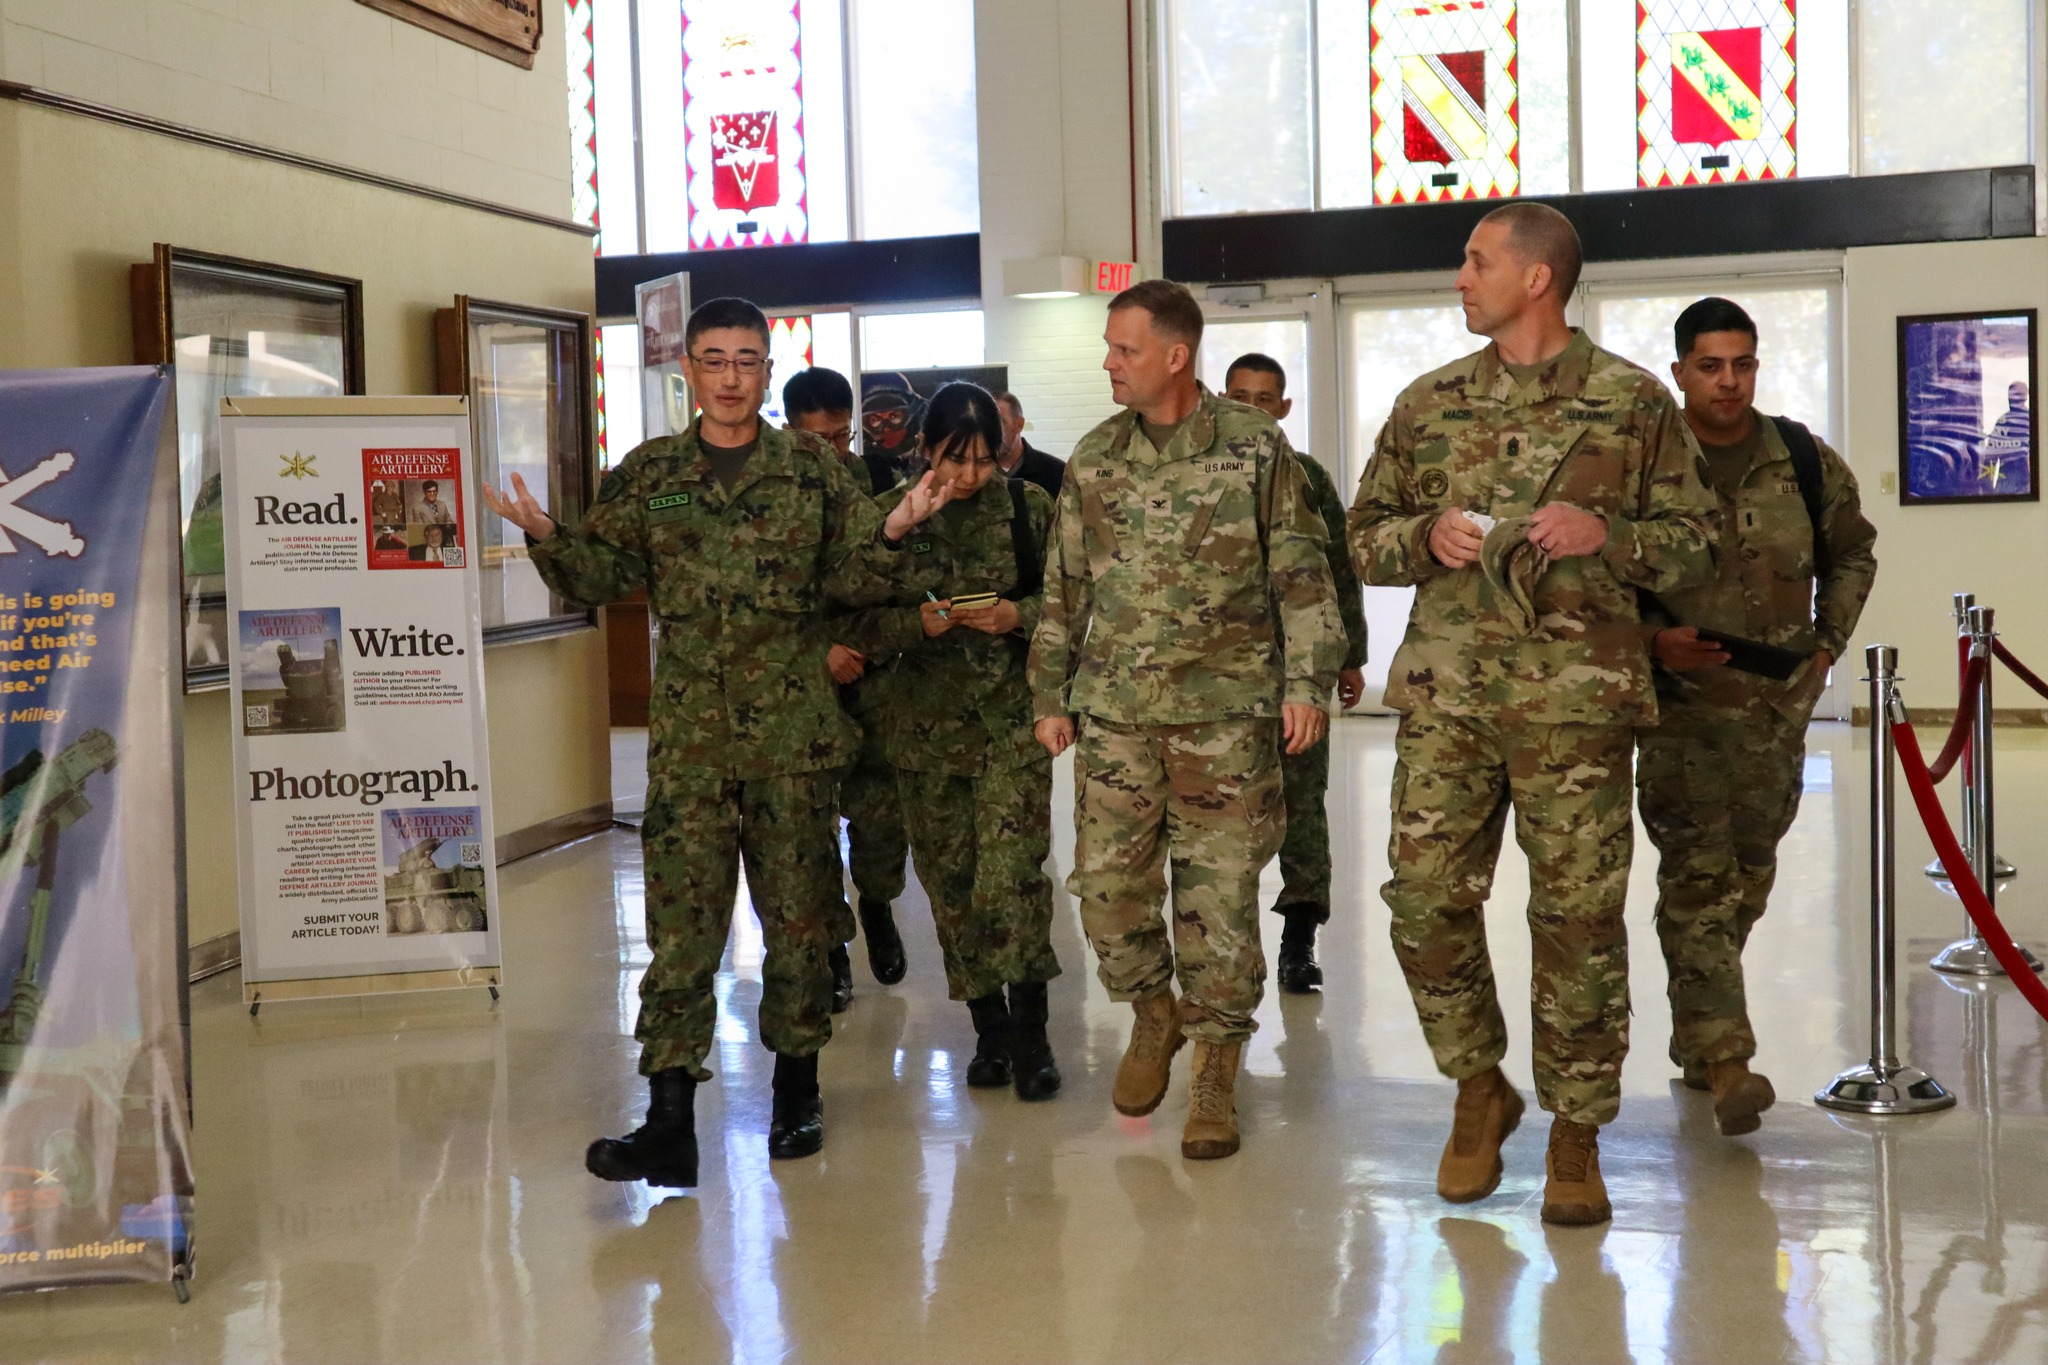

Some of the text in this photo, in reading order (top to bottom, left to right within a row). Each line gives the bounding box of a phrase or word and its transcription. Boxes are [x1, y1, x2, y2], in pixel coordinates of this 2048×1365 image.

[1098, 262, 1133, 292] EXIT
[372, 454, 449, 464] AIR DEFENSE
[380, 464, 445, 474] ARTILLERY
[1095, 468, 1114, 478] KING
[1220, 462, 1244, 472] ARMY
[651, 495, 686, 507] JAPAN
[254, 493, 358, 525] Read.
[24, 592, 43, 608] is
[49, 589, 115, 610] going
[0, 615, 17, 631] if
[348, 625, 464, 657] Write.
[57, 652, 92, 669] Air
[11, 707, 66, 723] Milley
[249, 761, 478, 805] Photograph.
[414, 815, 473, 827] DEFENSE
[398, 826, 468, 839] ARTILLERY
[301, 844, 342, 852] photographs
[304, 912, 379, 925] SUBMIT YOUR
[292, 925, 379, 938] ARTICLE TODAY!
[46, 1240, 146, 1260] multiplier
